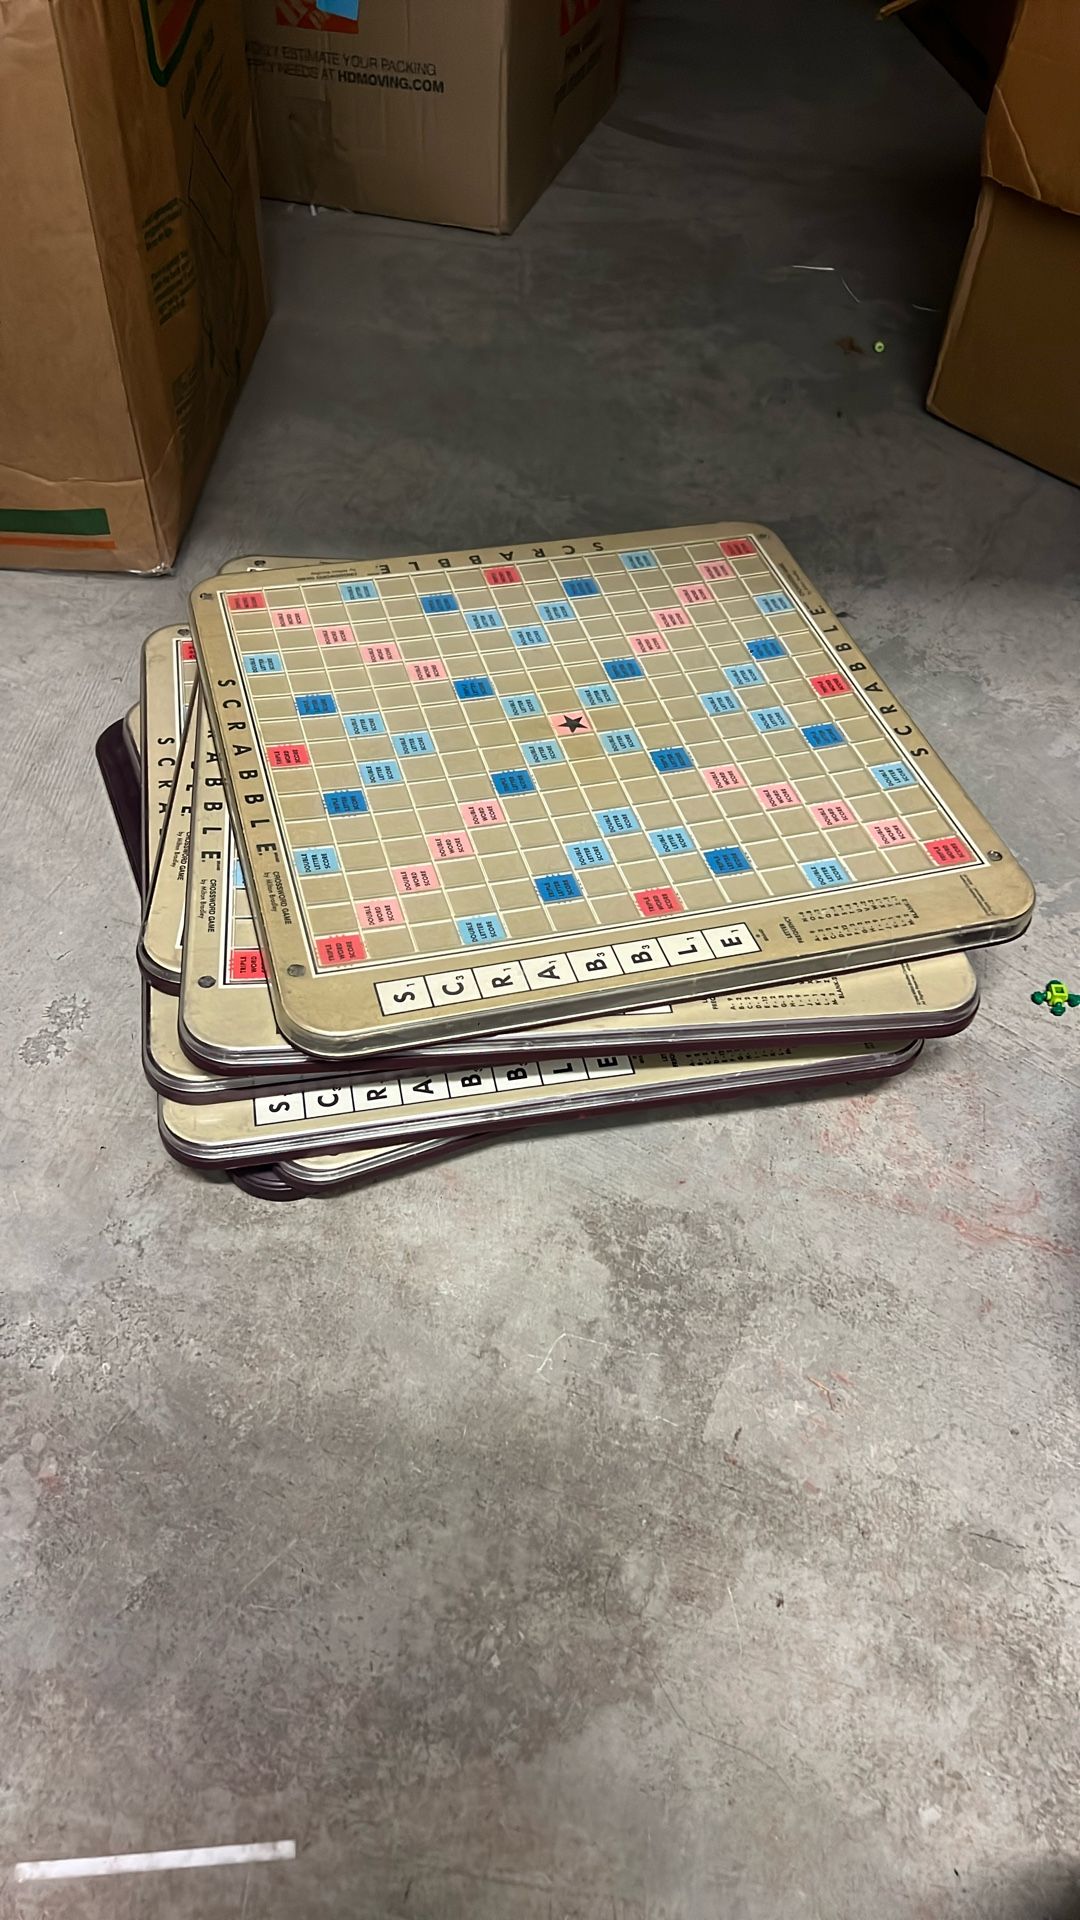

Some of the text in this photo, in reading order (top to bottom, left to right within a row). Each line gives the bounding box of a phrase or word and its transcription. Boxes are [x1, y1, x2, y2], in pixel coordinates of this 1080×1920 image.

[282, 46, 339, 66] ESTIMATE
[342, 54, 377, 69] YOUR
[381, 59, 436, 76] PACKING
[321, 68, 335, 81] AT
[338, 71, 444, 93] HDMOVING.COM
[709, 771, 723, 788] DOUBLE
[718, 771, 731, 785] WORD
[726, 770, 739, 784] SCORE
[878, 769, 894, 786] DOUBLE
[887, 769, 901, 783] LETTER
[895, 768, 909, 782] SCORE
[762, 789, 777, 806] DOUBLE
[772, 790, 785, 803] WORD
[780, 788, 793, 802] SCORE
[467, 806, 479, 824] DOUBLE
[477, 807, 488, 821] WORD
[486, 805, 497, 820] SCORE
[621, 813, 633, 828] SCORE
[817, 807, 833, 825] DOUBLE
[826, 808, 840, 822] WORD
[835, 806, 849, 821] SCORE
[602, 814, 616, 832] DOUBLE
[612, 814, 624, 830] LETTER
[675, 832, 688, 848] SCORE
[873, 826, 890, 844] DOUBLE
[883, 826, 898, 841] WORD
[891, 824, 906, 840] SCORE
[434, 838, 446, 857] DOUBLE
[444, 839, 455, 854] WORD
[453, 837, 465, 853] SCORE
[656, 834, 671, 852] DOUBLE
[666, 834, 679, 849] LETTER
[573, 846, 587, 865] DOUBLE
[583, 846, 595, 862] LETTER
[592, 845, 605, 861] SCORE
[932, 846, 948, 860] TRIPLE
[941, 844, 956, 859] WORD
[949, 842, 965, 858] SCORE
[301, 854, 312, 873] DOUBLE
[311, 854, 321, 870] LETTER
[320, 852, 331, 868] SCORE
[177, 865, 186, 880] GAME
[410, 871, 421, 887] WORD
[419, 870, 431, 886] SCORE
[810, 866, 826, 885] DOUBLE
[819, 866, 834, 882] LETTER
[828, 865, 843, 881] SCORE
[399, 871, 412, 891] DOUBLE
[208, 879, 217, 932] CROSSWORD GAME
[273, 871, 292, 925] CROSSWORD GAME
[642, 896, 655, 912] TRIPLE
[651, 894, 665, 911] WORD
[661, 892, 674, 909] SCORE
[363, 905, 375, 926] DOUBLE
[373, 906, 384, 922] WORD
[383, 904, 394, 921] SCORE
[464, 922, 478, 943] DOUBLE
[475, 922, 487, 940] LETTER
[485, 920, 497, 938] SCORE
[325, 944, 336, 961] TRIPLE
[335, 942, 346, 960] WORD
[345, 940, 357, 958] SCORE
